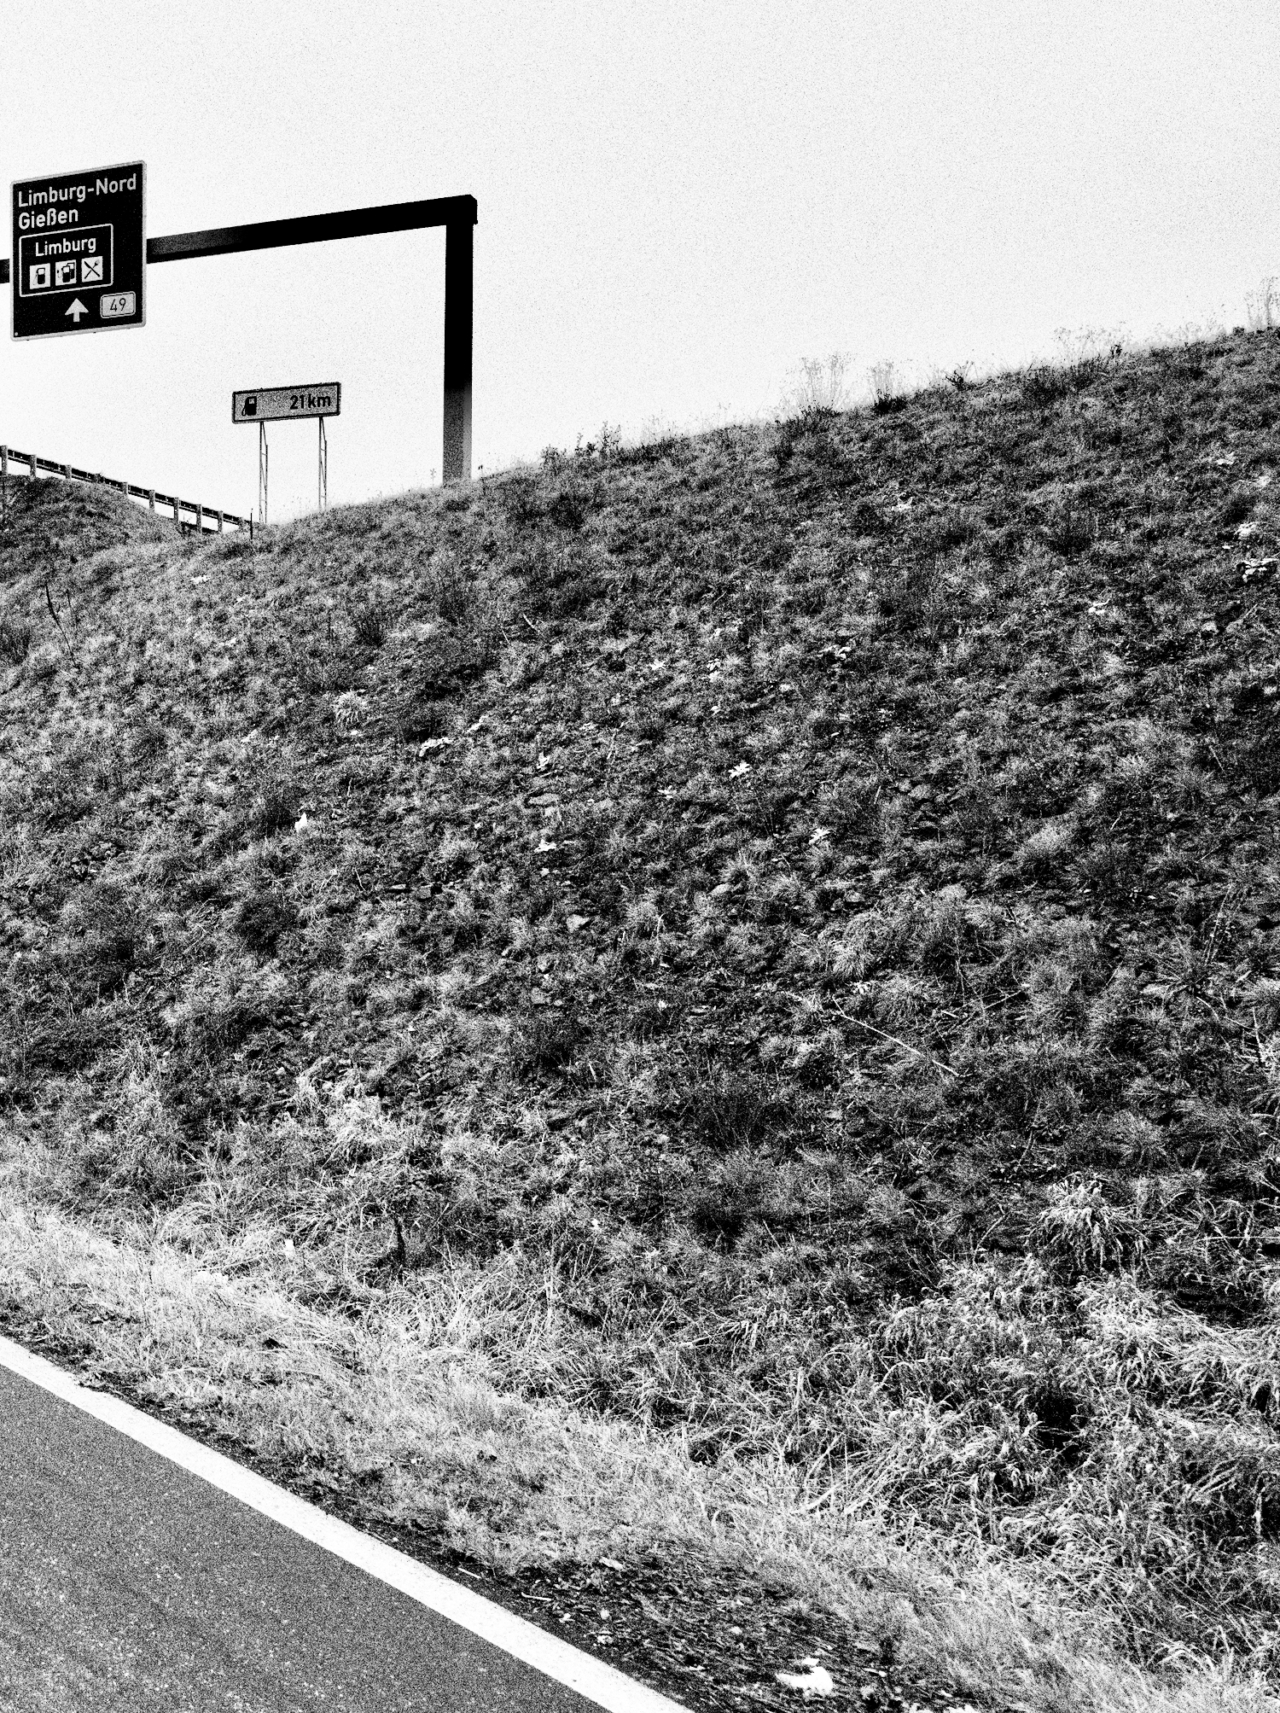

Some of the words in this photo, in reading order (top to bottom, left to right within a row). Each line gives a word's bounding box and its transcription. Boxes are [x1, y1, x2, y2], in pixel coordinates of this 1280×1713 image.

[18, 173, 136, 207] Limburg-Nord
[18, 208, 79, 230] Gießen
[35, 237, 97, 257] Limburg
[109, 297, 127, 312] 49
